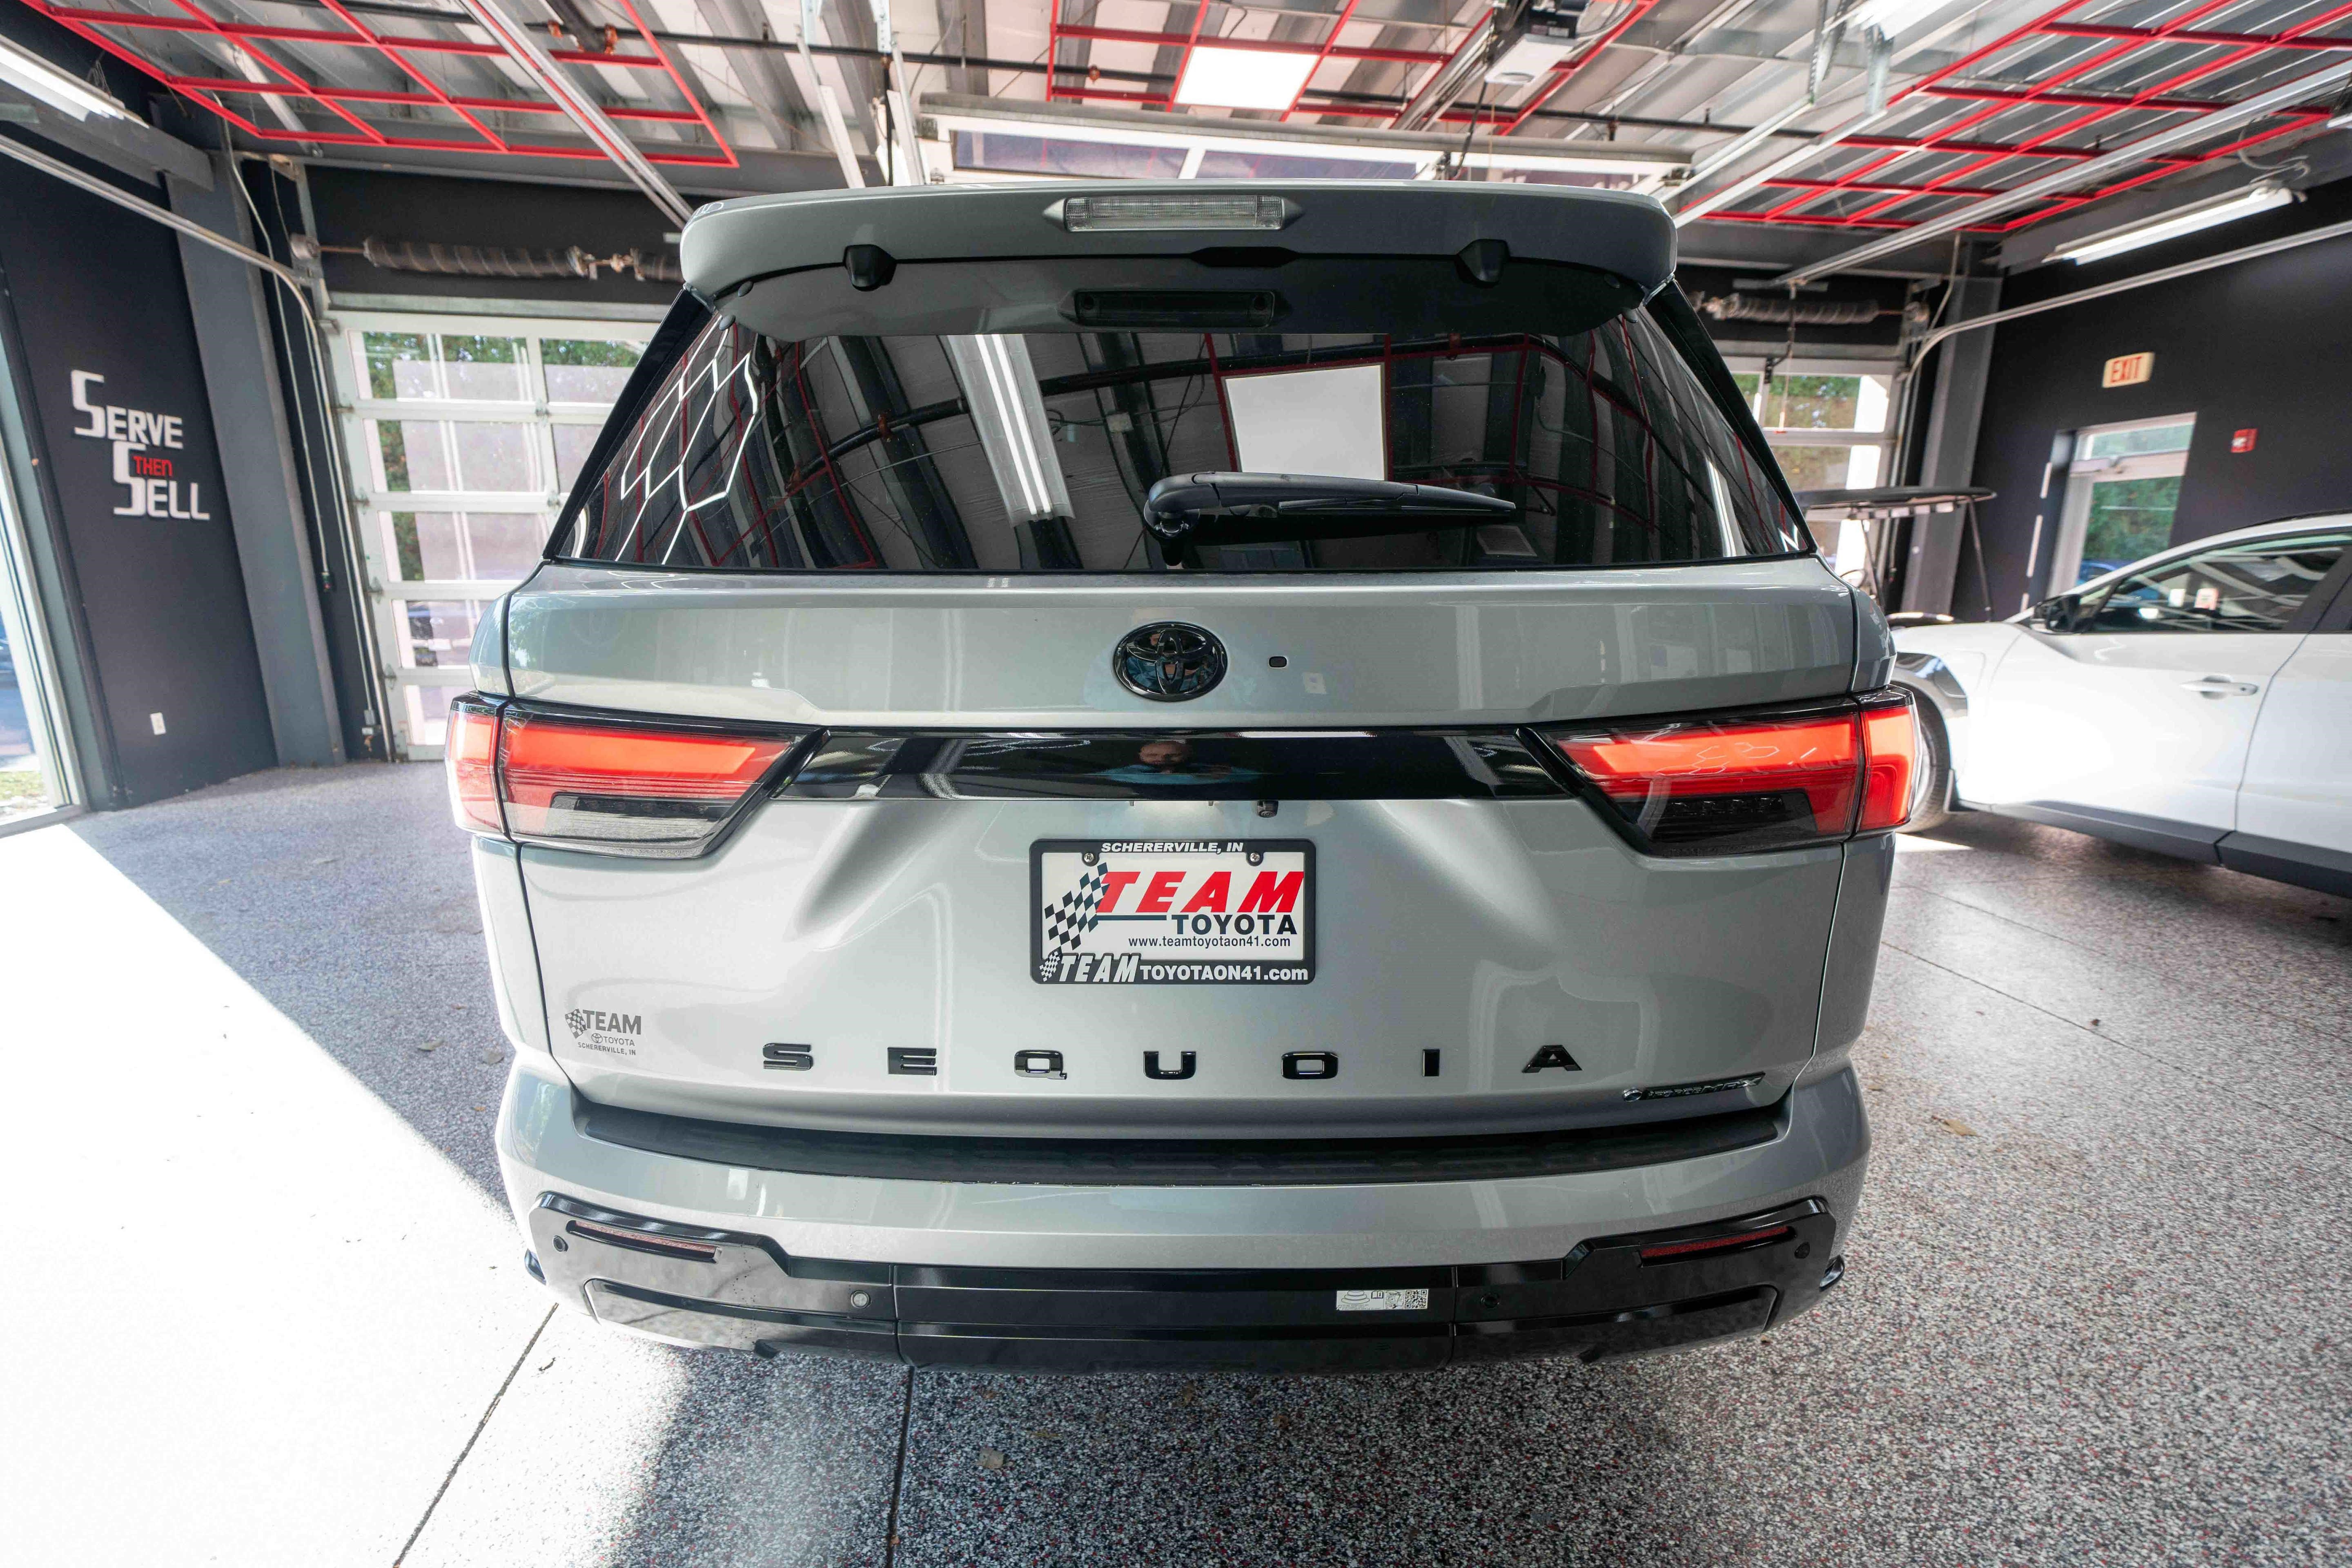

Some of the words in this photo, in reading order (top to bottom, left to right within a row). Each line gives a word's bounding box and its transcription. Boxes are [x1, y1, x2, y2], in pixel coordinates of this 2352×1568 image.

[2111, 356, 2142, 383] EXIT
[71, 369, 183, 449] SERVE
[113, 441, 210, 521] SELL
[1101, 842, 1222, 854] SCHERERVILLE,
[1226, 842, 1244, 852] IN
[1095, 871, 1304, 913] TEAM
[1171, 914, 1298, 935] TOYOTA
[1128, 935, 1291, 949] www.teamtoyotaon41.com
[1059, 954, 1139, 982] TEAM
[1139, 964, 1308, 980] TOYOTAON41.com
[582, 1009, 641, 1035] TEAM
[577, 1042, 627, 1055] SCHERERVILLE,
[603, 1036, 635, 1047] TOYOTA
[762, 1042, 1583, 1080] SEQUOIA
